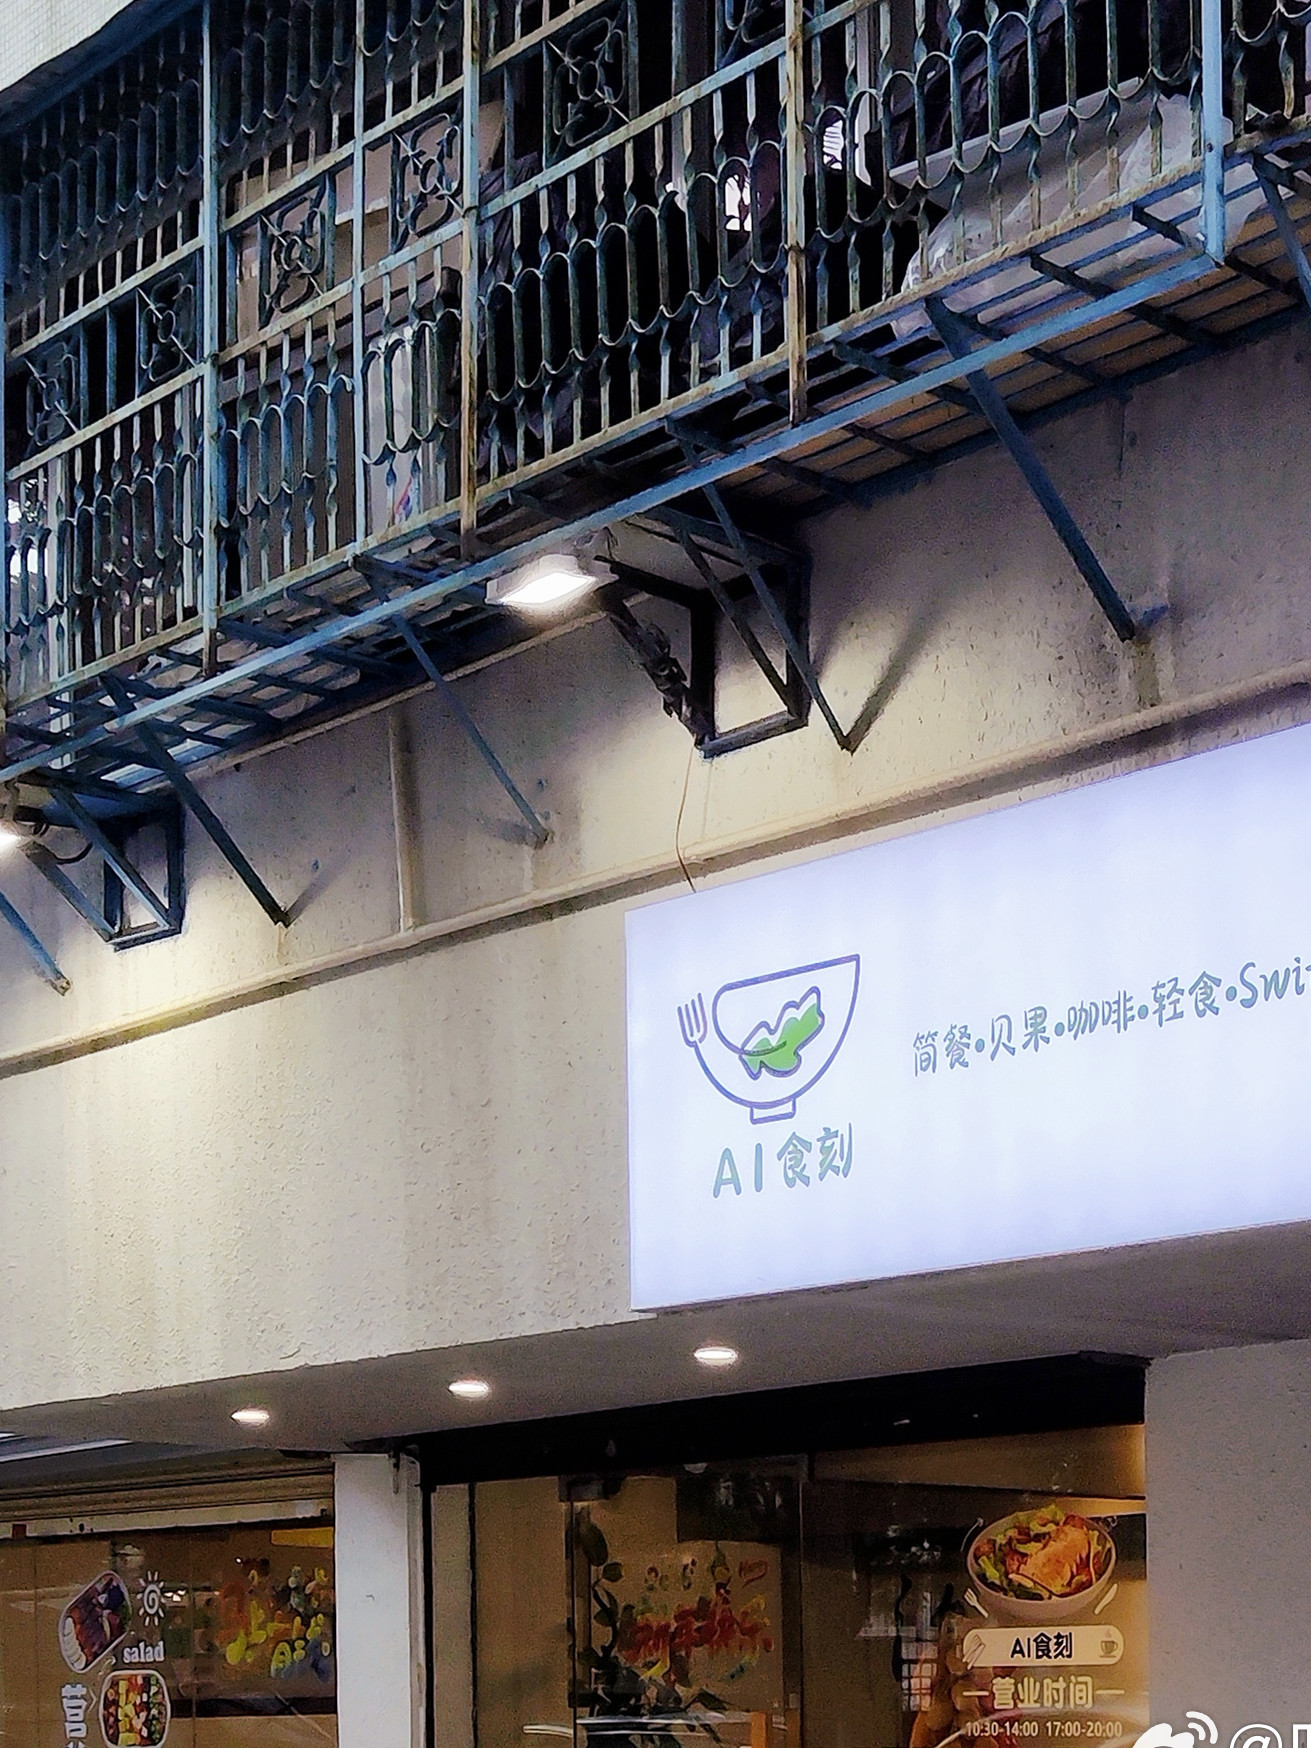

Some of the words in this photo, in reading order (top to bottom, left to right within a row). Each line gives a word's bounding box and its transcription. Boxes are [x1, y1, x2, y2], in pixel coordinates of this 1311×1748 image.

[122, 1640, 165, 1665] salad
[1010, 1632, 1075, 1661] AI食刻
[991, 1676, 1095, 1711] 营业时间
[965, 1721, 1039, 1738] 10:30-14:00
[1046, 1721, 1123, 1738] 17:00-20:00
